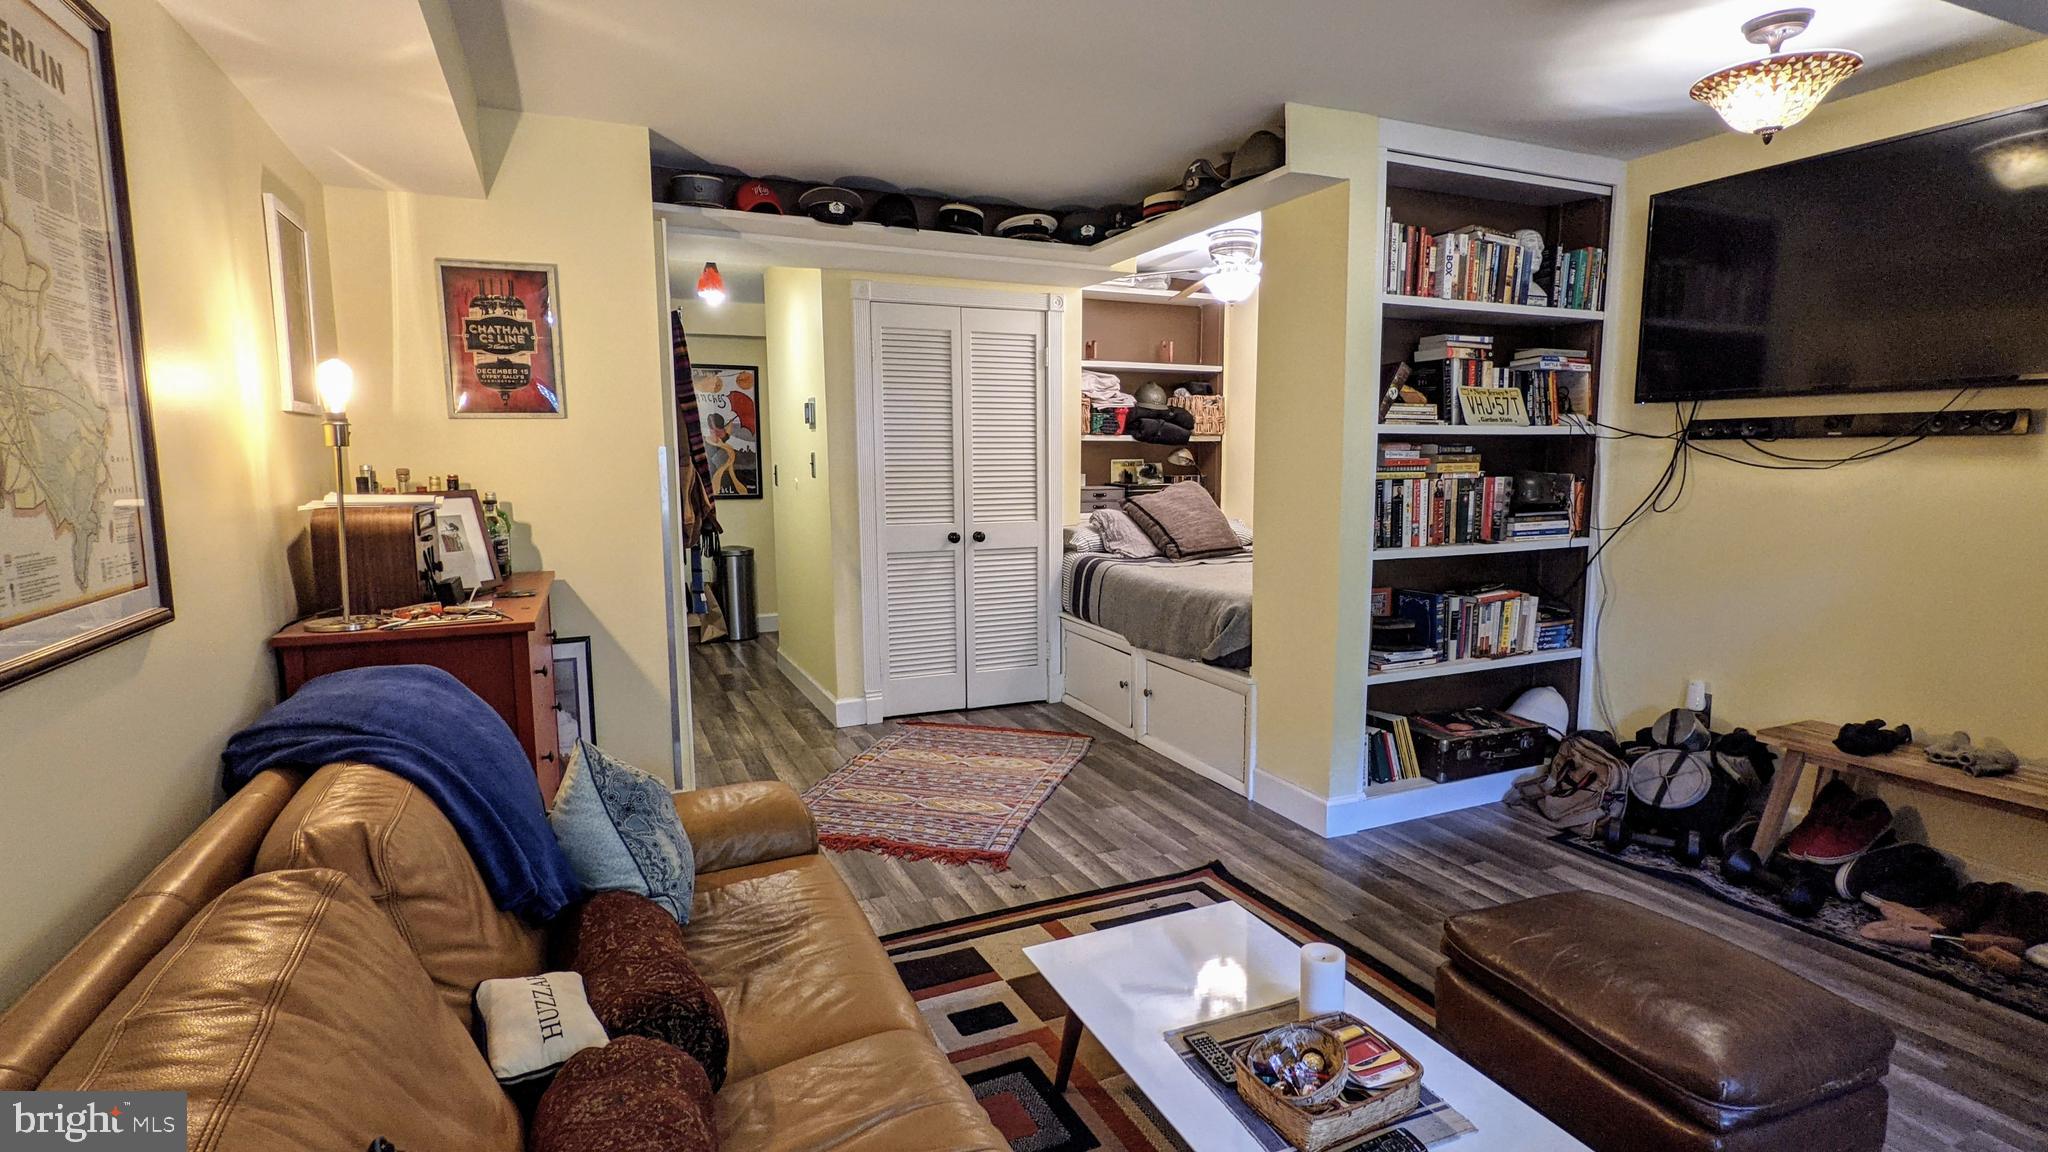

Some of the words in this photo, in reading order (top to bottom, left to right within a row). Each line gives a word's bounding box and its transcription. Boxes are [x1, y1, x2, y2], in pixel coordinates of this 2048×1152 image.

[1446, 255, 1454, 276] BOX
[468, 324, 529, 335] CHATHAM
[497, 334, 526, 344] LINE
